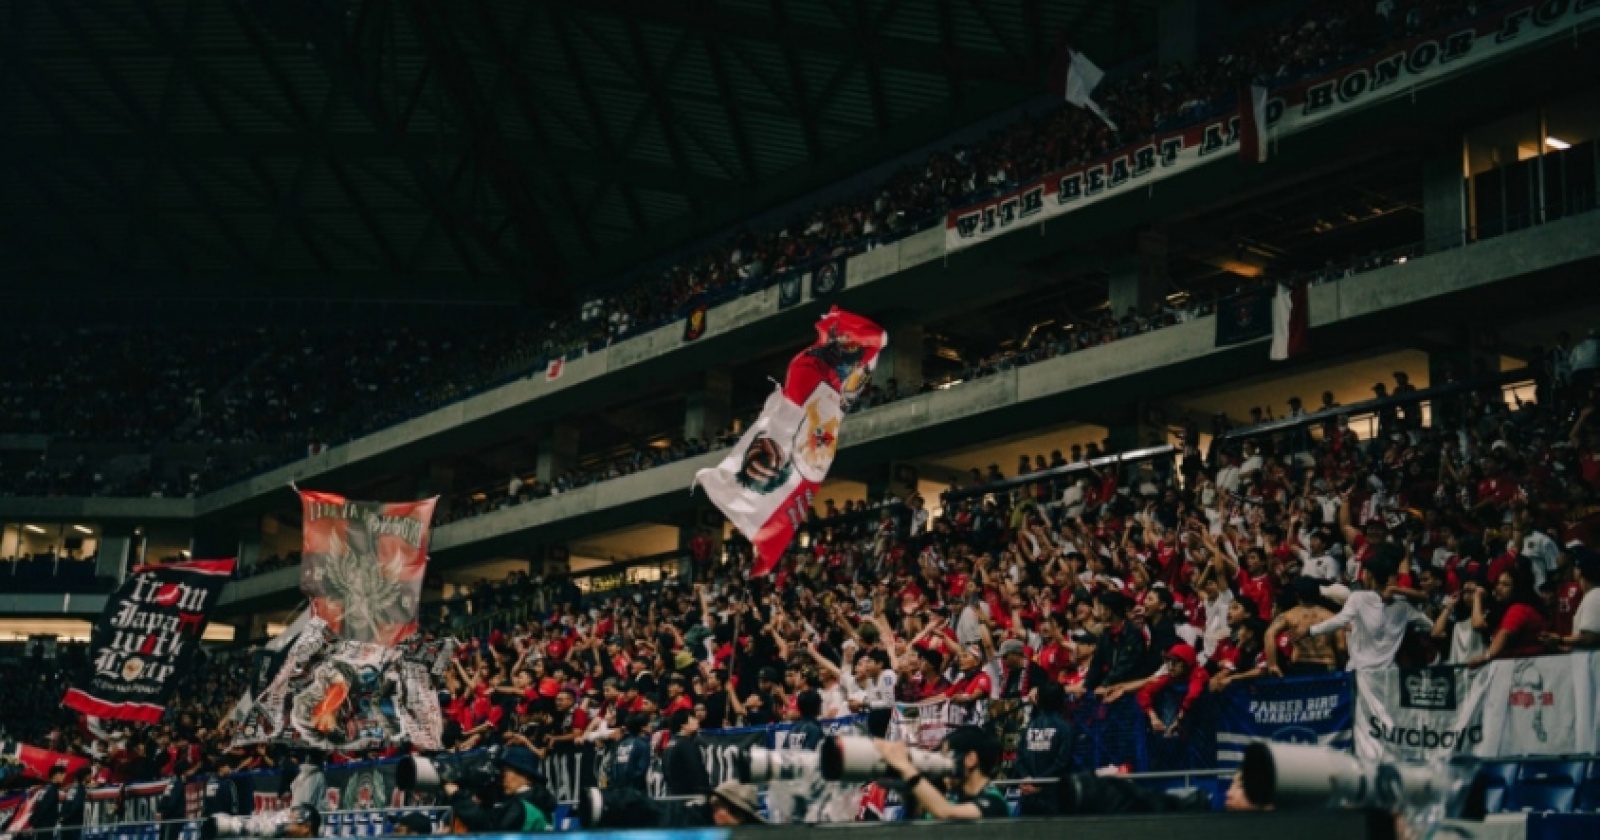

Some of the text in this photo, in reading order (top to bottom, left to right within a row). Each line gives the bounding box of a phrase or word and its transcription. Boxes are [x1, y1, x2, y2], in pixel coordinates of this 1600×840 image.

[957, 184, 1044, 237] WITH
[1058, 136, 1183, 204] HEART
[1303, 28, 1477, 116] HONOR
[1368, 716, 1483, 751] Surabaya
